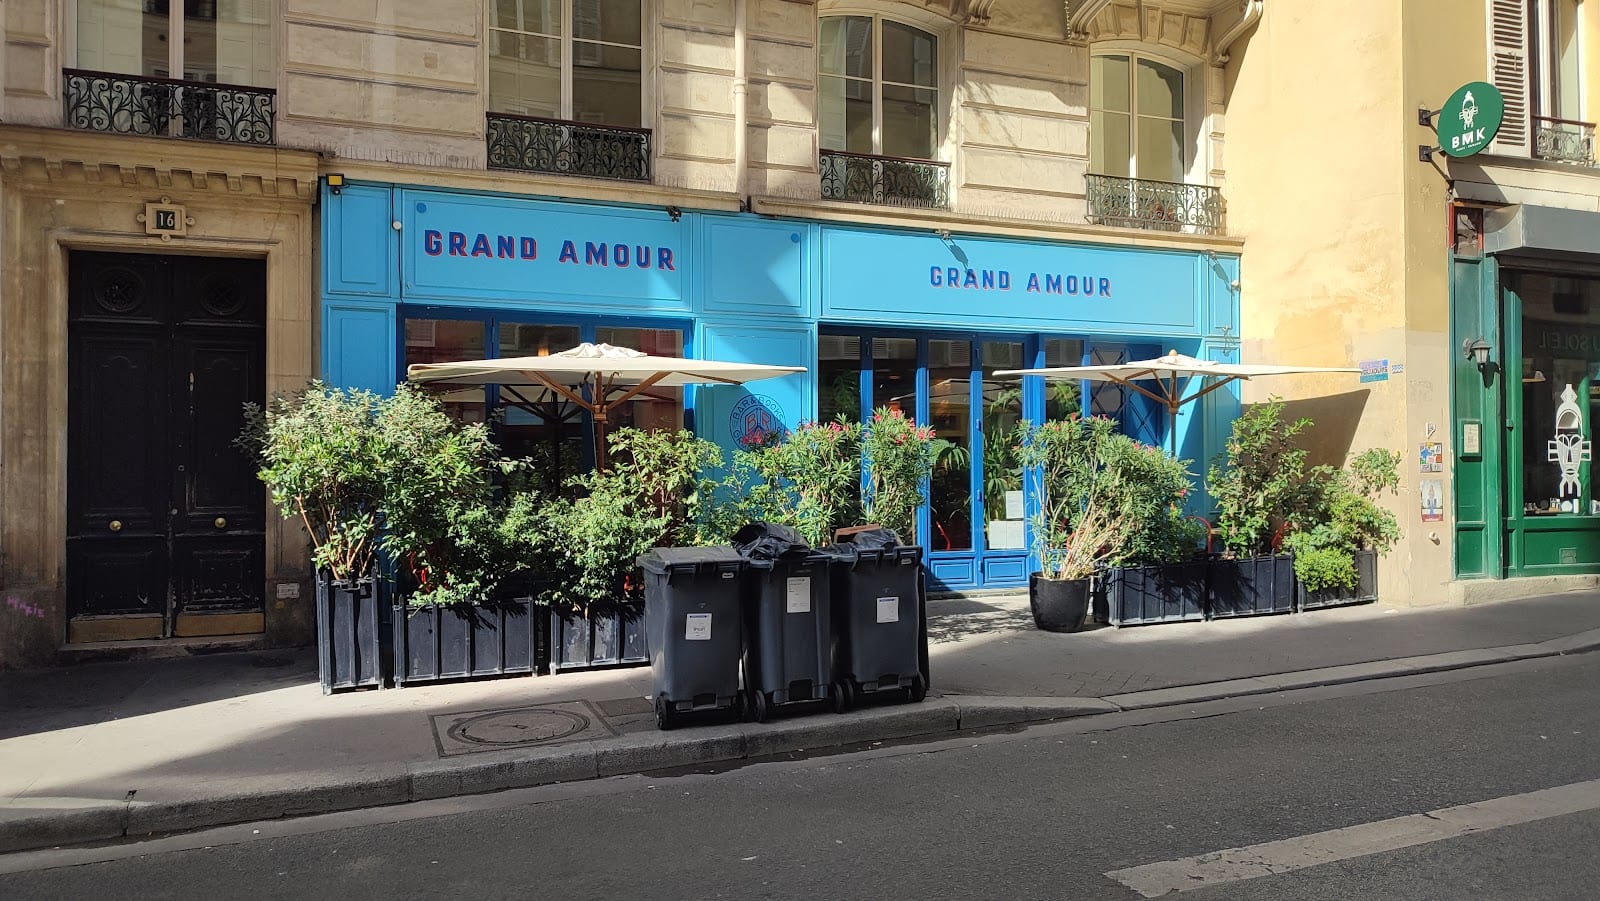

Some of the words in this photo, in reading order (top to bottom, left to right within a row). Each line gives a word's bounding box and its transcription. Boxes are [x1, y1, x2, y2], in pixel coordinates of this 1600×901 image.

[1451, 126, 1486, 149] BMK
[159, 212, 175, 227] 16
[424, 229, 537, 260] GRAND
[558, 239, 676, 271] AMOUR
[930, 265, 1011, 291] GRAND
[1026, 272, 1112, 298] AMOUR
